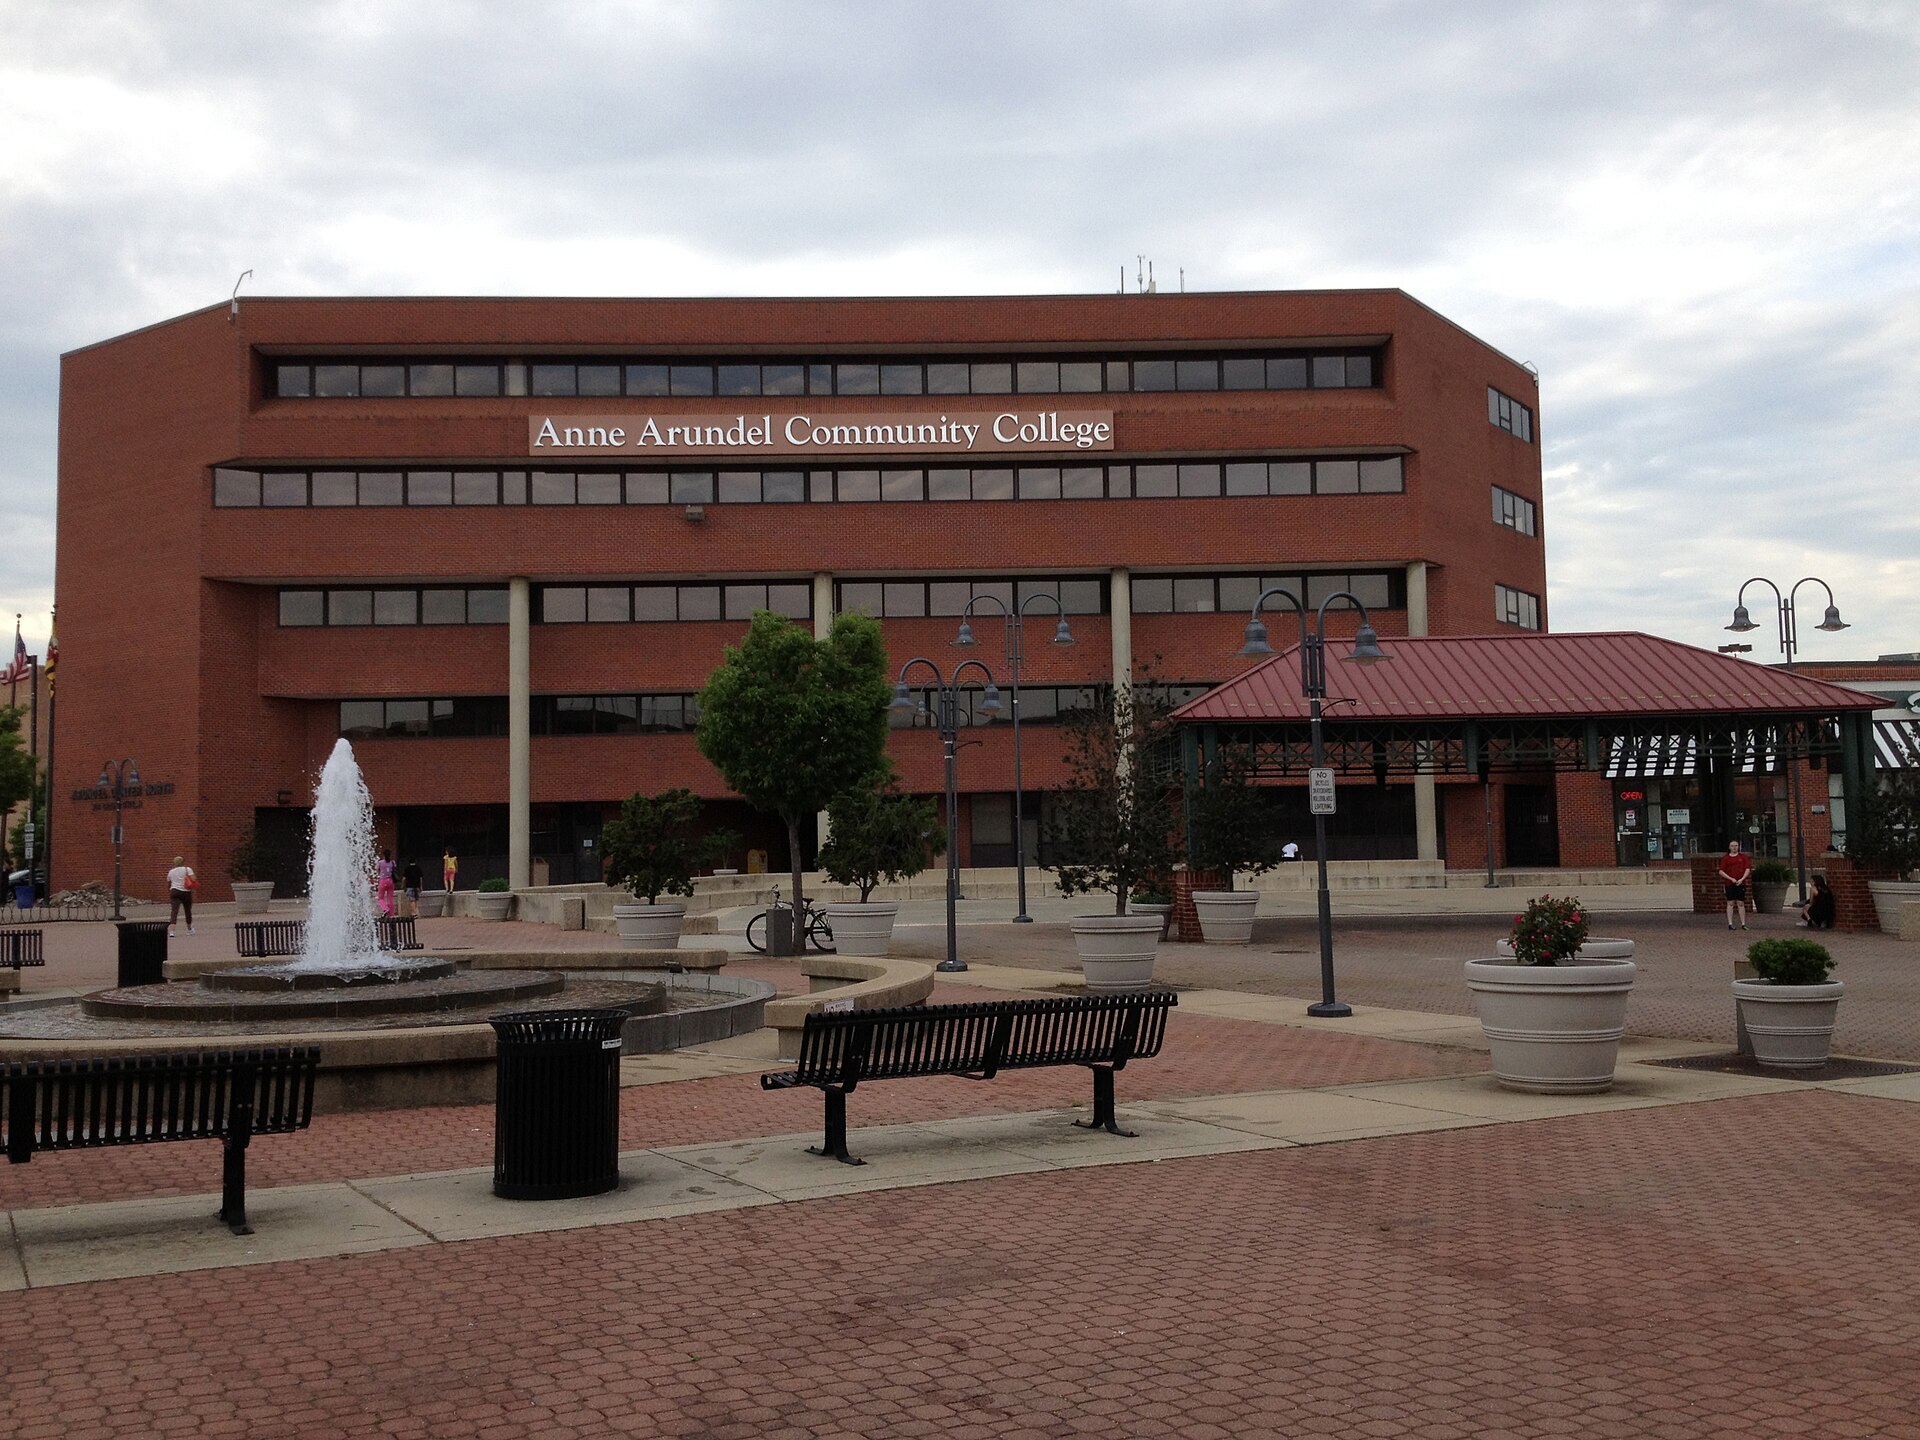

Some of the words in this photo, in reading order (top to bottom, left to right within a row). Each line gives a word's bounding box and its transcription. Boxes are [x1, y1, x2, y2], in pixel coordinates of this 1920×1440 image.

[534, 417, 626, 447] Anne
[636, 415, 773, 447] Arundel
[784, 415, 980, 449] Community
[992, 412, 1110, 448] College
[1316, 771, 1327, 779] NO
[1620, 791, 1643, 800] OPEN
